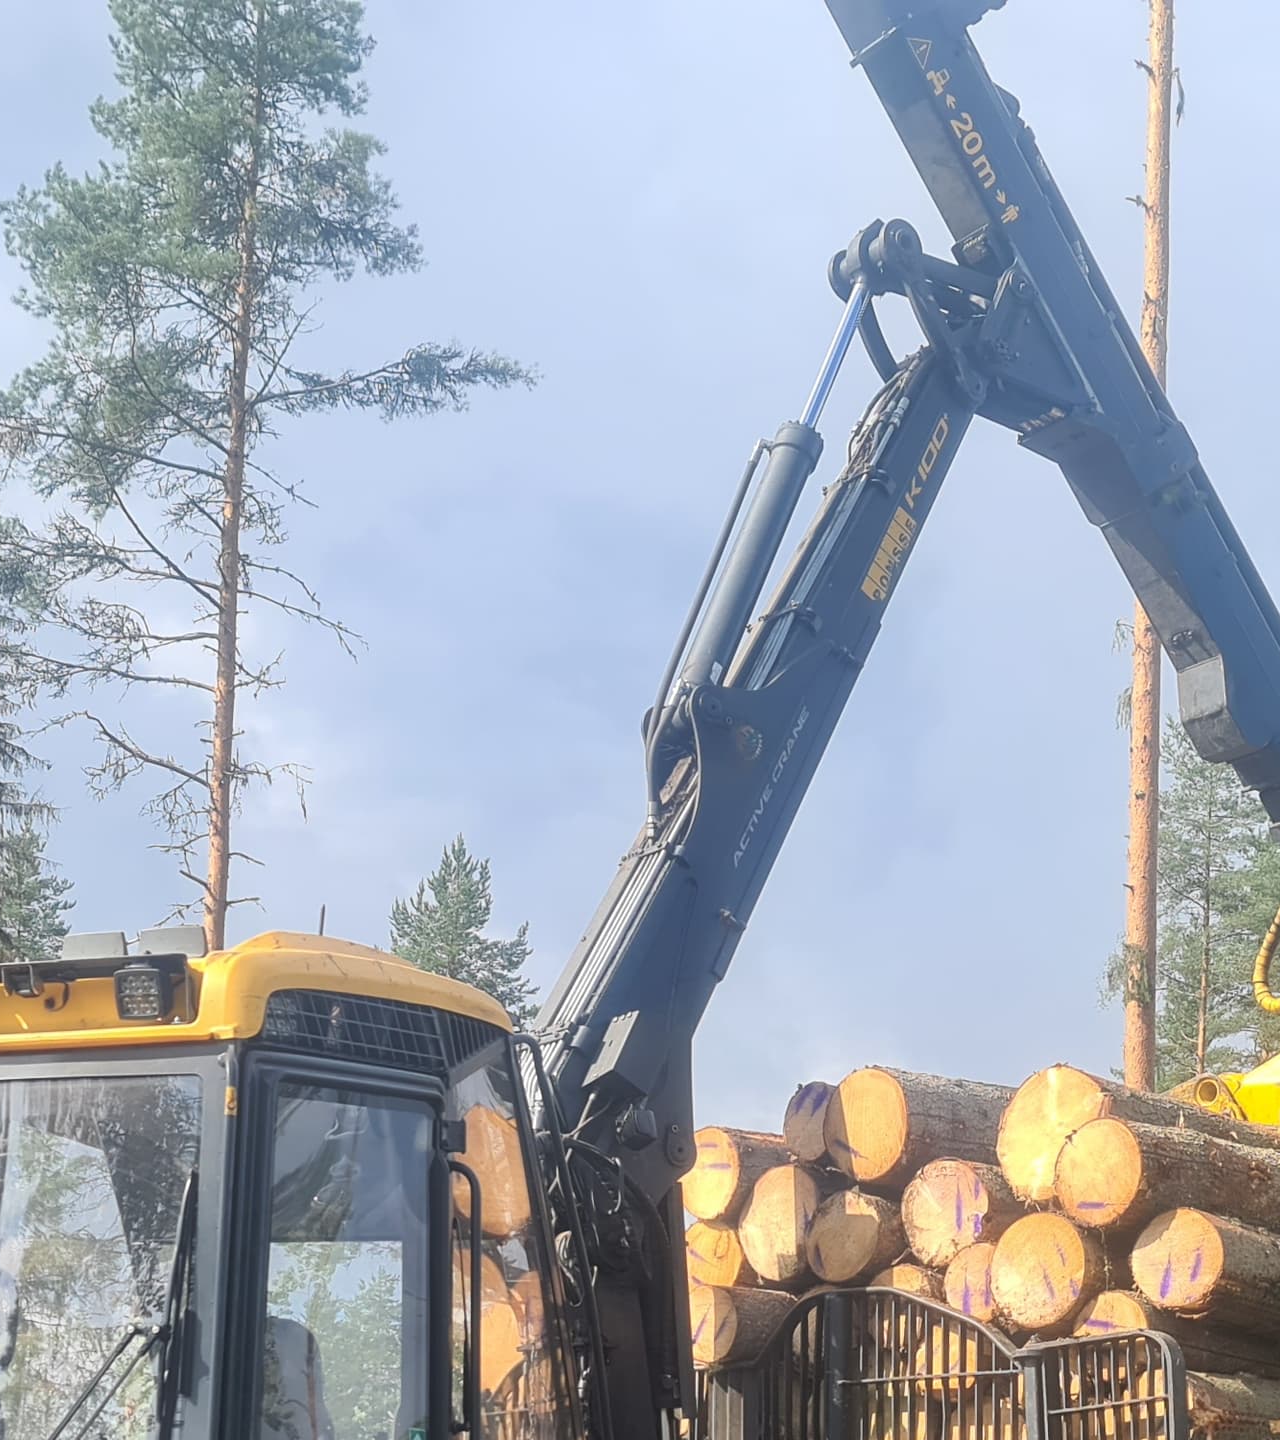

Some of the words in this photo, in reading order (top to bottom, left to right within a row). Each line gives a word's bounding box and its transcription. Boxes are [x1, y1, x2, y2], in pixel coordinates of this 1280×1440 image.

[949, 111, 997, 190] 20m
[871, 517, 917, 600] PONSSE
[733, 783, 773, 868] ACTIVE
[772, 705, 810, 783] CRANE
